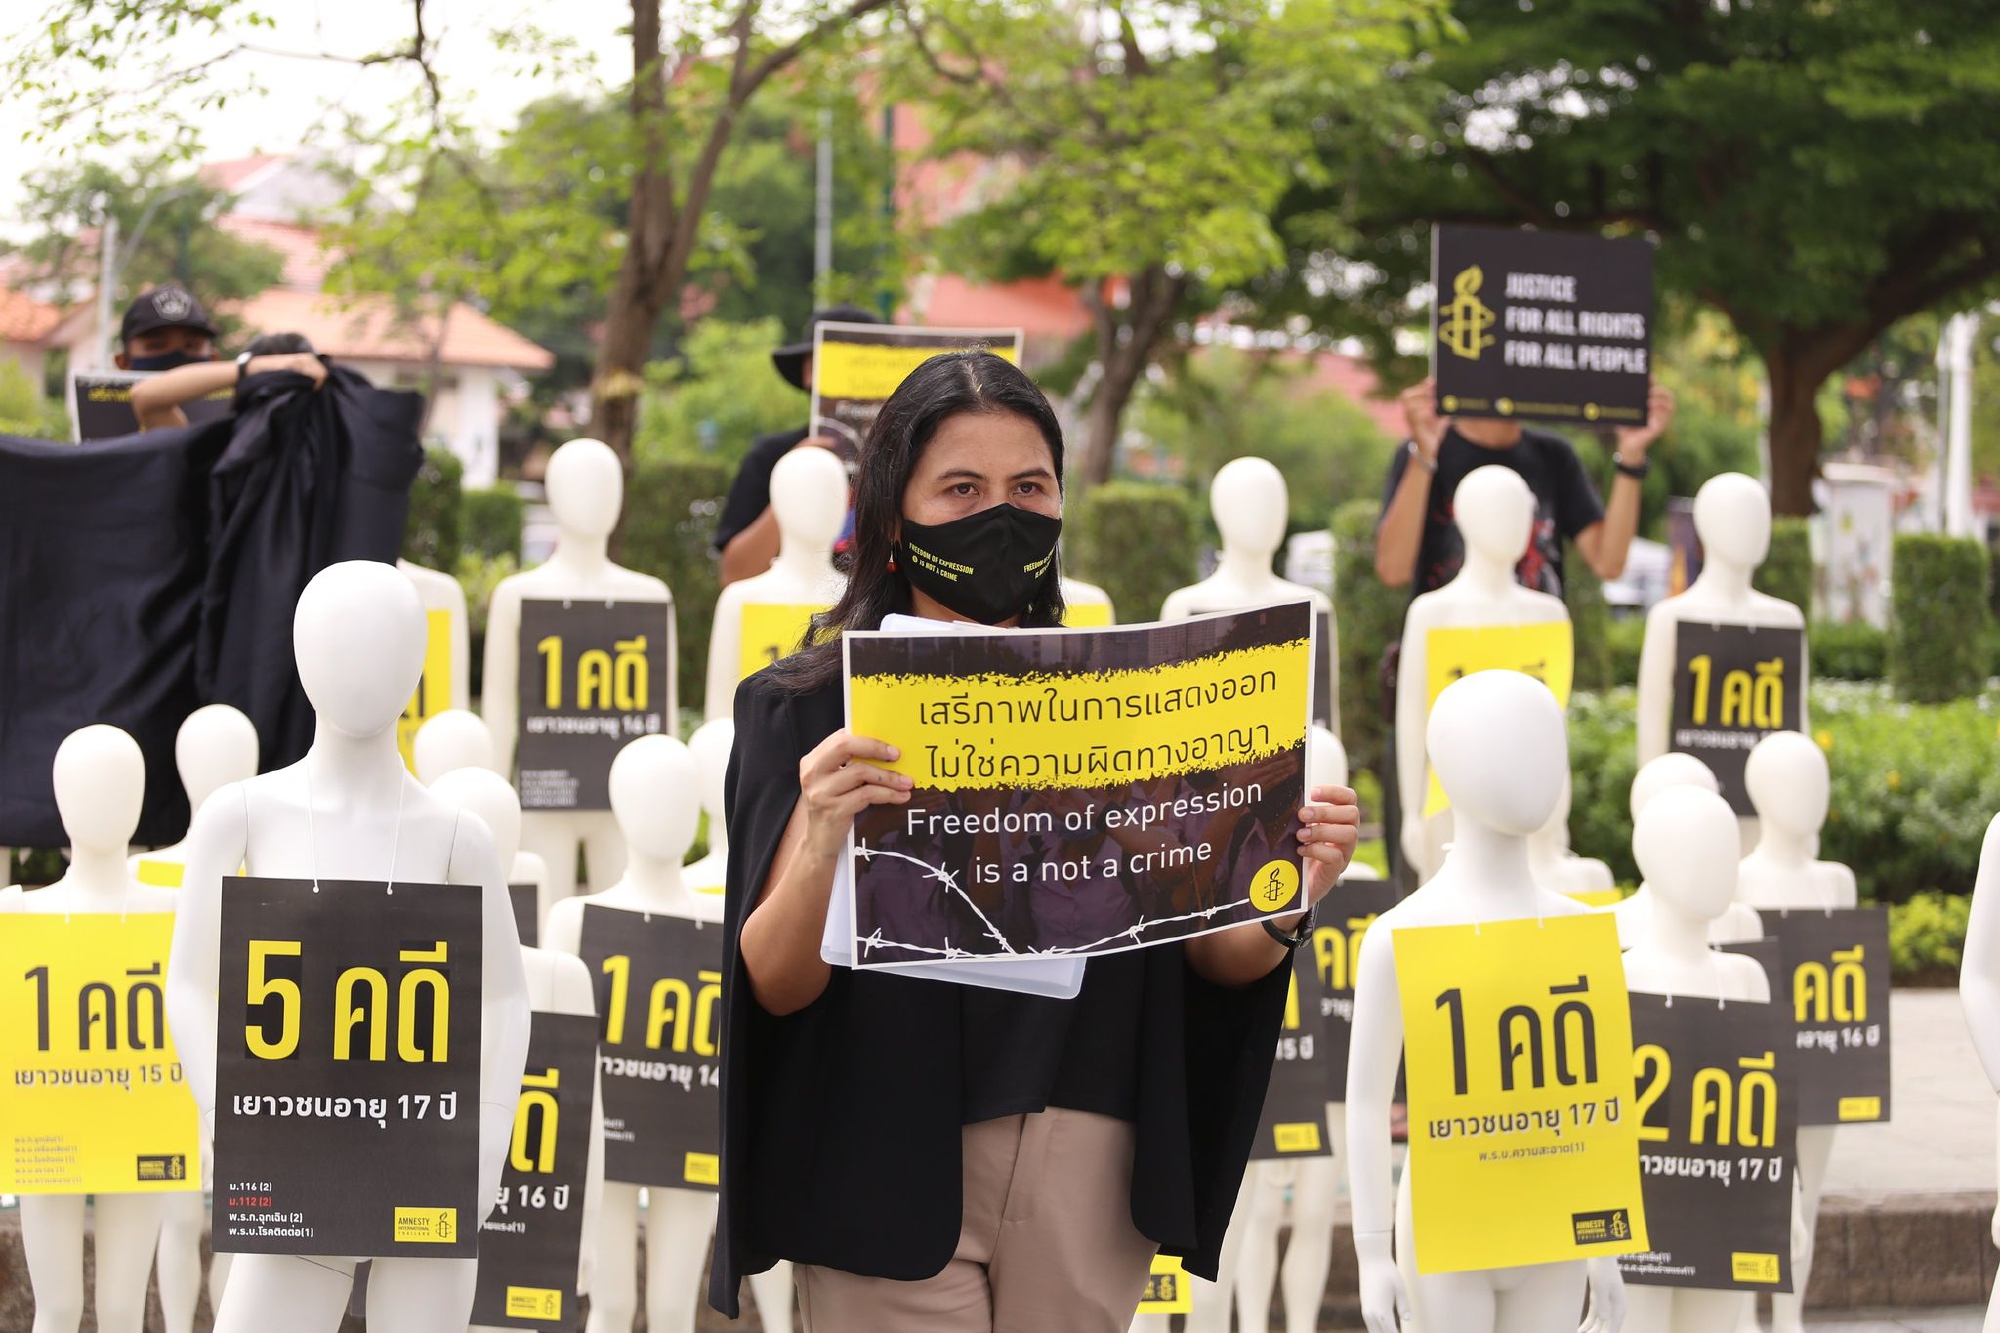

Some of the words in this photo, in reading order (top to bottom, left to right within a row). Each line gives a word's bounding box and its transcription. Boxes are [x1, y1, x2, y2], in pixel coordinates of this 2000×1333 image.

[1504, 271, 1577, 302] JUSTICE
[1505, 306, 1544, 333] FOR
[1544, 308, 1578, 336] ALL
[1578, 311, 1645, 340] RIGHTS
[1504, 340, 1543, 367] FOR
[1543, 342, 1577, 370] ALL
[1578, 344, 1647, 374] PEOPLE
[909, 542, 932, 559] FREEDOM
[932, 555, 938, 563] OF
[938, 558, 974, 575] EXPRESSION
[919, 559, 925, 567] IS
[925, 562, 936, 572] NOT
[940, 569, 958, 582] CRIME
[537, 635, 562, 710] 1
[576, 634, 649, 711] คดี
[1688, 654, 1712, 726] 1
[1720, 657, 1784, 729] คดี
[920, 671, 1276, 724] เสรีภาพในการแสดงออก
[925, 724, 1269, 778] ไม่ใช่ความผิดทางอาญา
[907, 807, 1052, 835] Freedom
[1065, 804, 1095, 831] of
[1105, 782, 1262, 832] expression
[976, 856, 1000, 883] is
[1012, 862, 1028, 882] a
[1042, 855, 1091, 882] not
[1103, 858, 1118, 878] a
[1130, 842, 1212, 874] crime
[25, 966, 50, 1051] 1
[79, 962, 164, 1051] คดี
[246, 940, 301, 1060] 5
[334, 941, 449, 1062] คดี
[602, 954, 630, 1044] 1
[1435, 988, 1468, 1095] 1
[1498, 975, 1598, 1091] คดี
[15, 1069, 130, 1091] เยาวชนอายุ
[140, 1065, 162, 1083] 15
[170, 1062, 183, 1082] ปี
[600, 1056, 693, 1092] าวชนอายุ
[233, 1095, 387, 1129] เยาวชนอายุ
[398, 1095, 431, 1119] 17
[439, 1091, 457, 1120] ปี
[1634, 1044, 1671, 1143] 2
[1689, 1051, 1777, 1148] คดี
[510, 1068, 559, 1173] ดี
[1428, 1109, 1560, 1139] เยาวชนอายุ
[1569, 1103, 1596, 1126] 17
[1605, 1097, 1620, 1122] ปี
[229, 1182, 257, 1191] ม.116
[1640, 1154, 1731, 1187] าวชนอายุ
[1738, 1157, 1764, 1181] 17
[1768, 1156, 1783, 1182] ปี
[229, 1197, 256, 1206] ม.112
[519, 1185, 546, 1209] 16
[553, 1184, 570, 1211] ปี
[290, 1213, 303, 1223] (2)
[398, 1217, 430, 1225] AMNESTY
